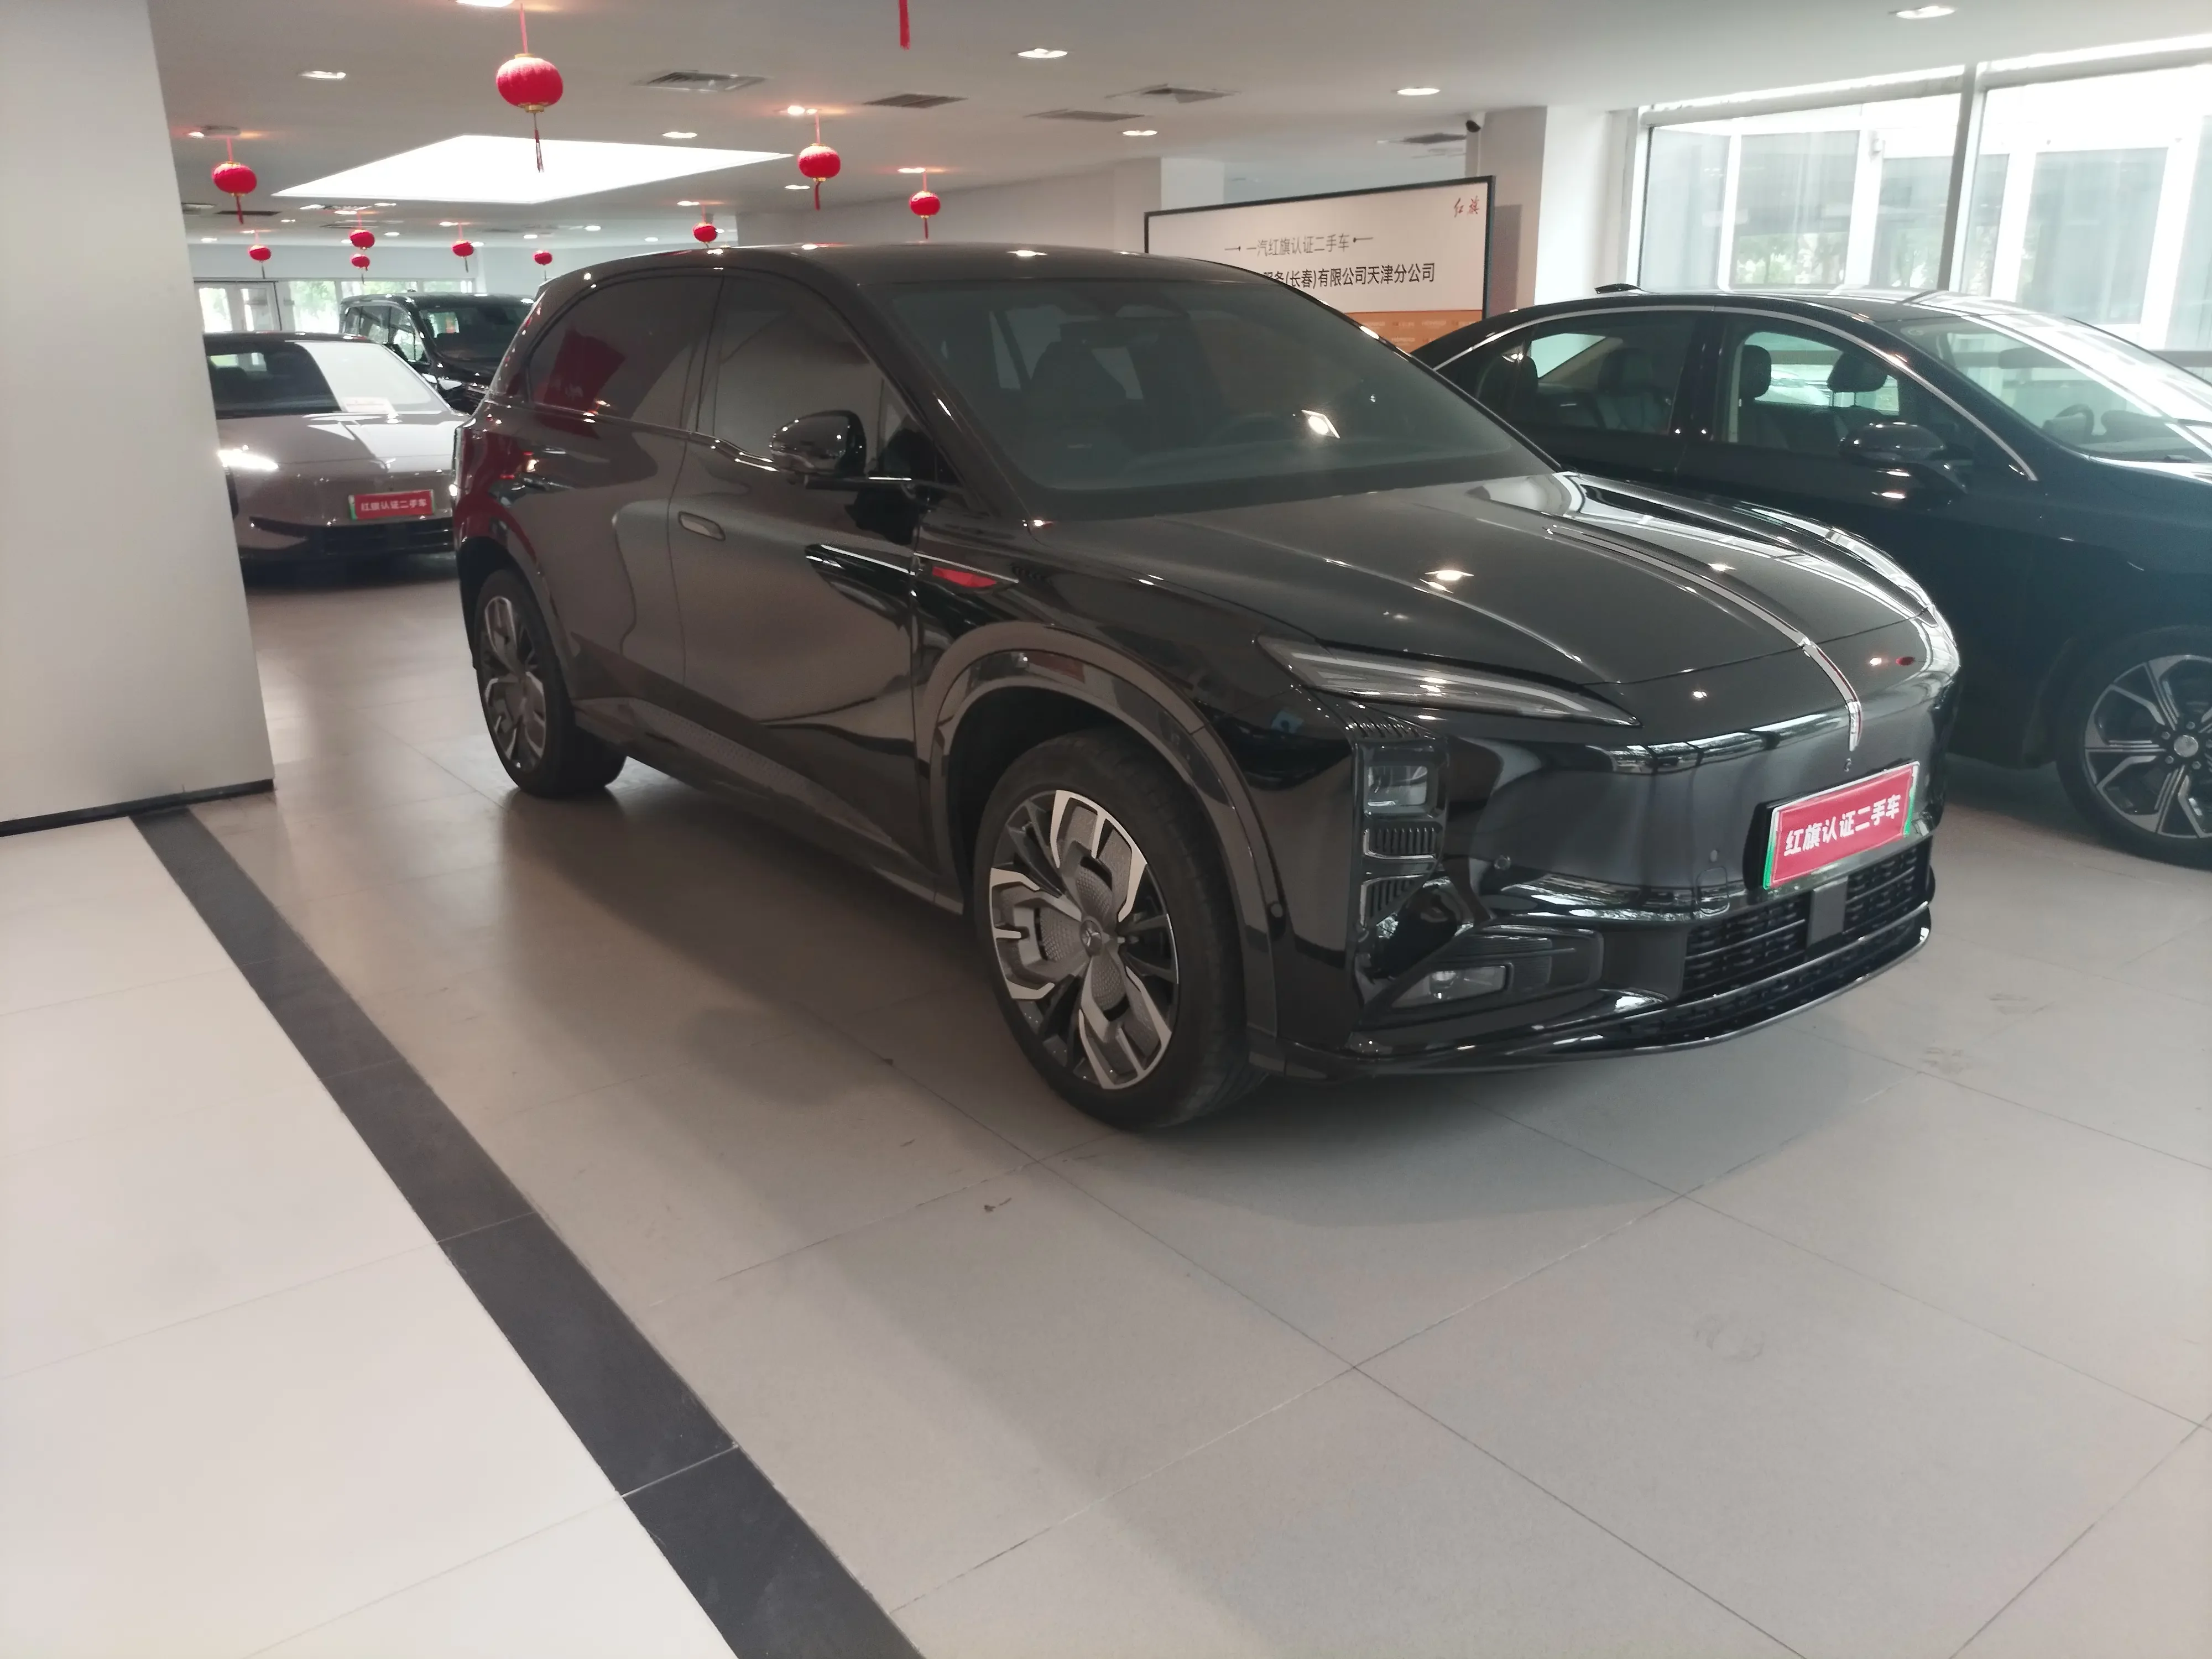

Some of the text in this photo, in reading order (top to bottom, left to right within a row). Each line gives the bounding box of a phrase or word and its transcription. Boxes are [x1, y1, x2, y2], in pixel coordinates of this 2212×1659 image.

[1245, 232, 1350, 257] 一汽红旗认证二手车
[361, 499, 427, 512] 红旗认证二手车
[1783, 794, 1901, 857] 红旗认证二手车
